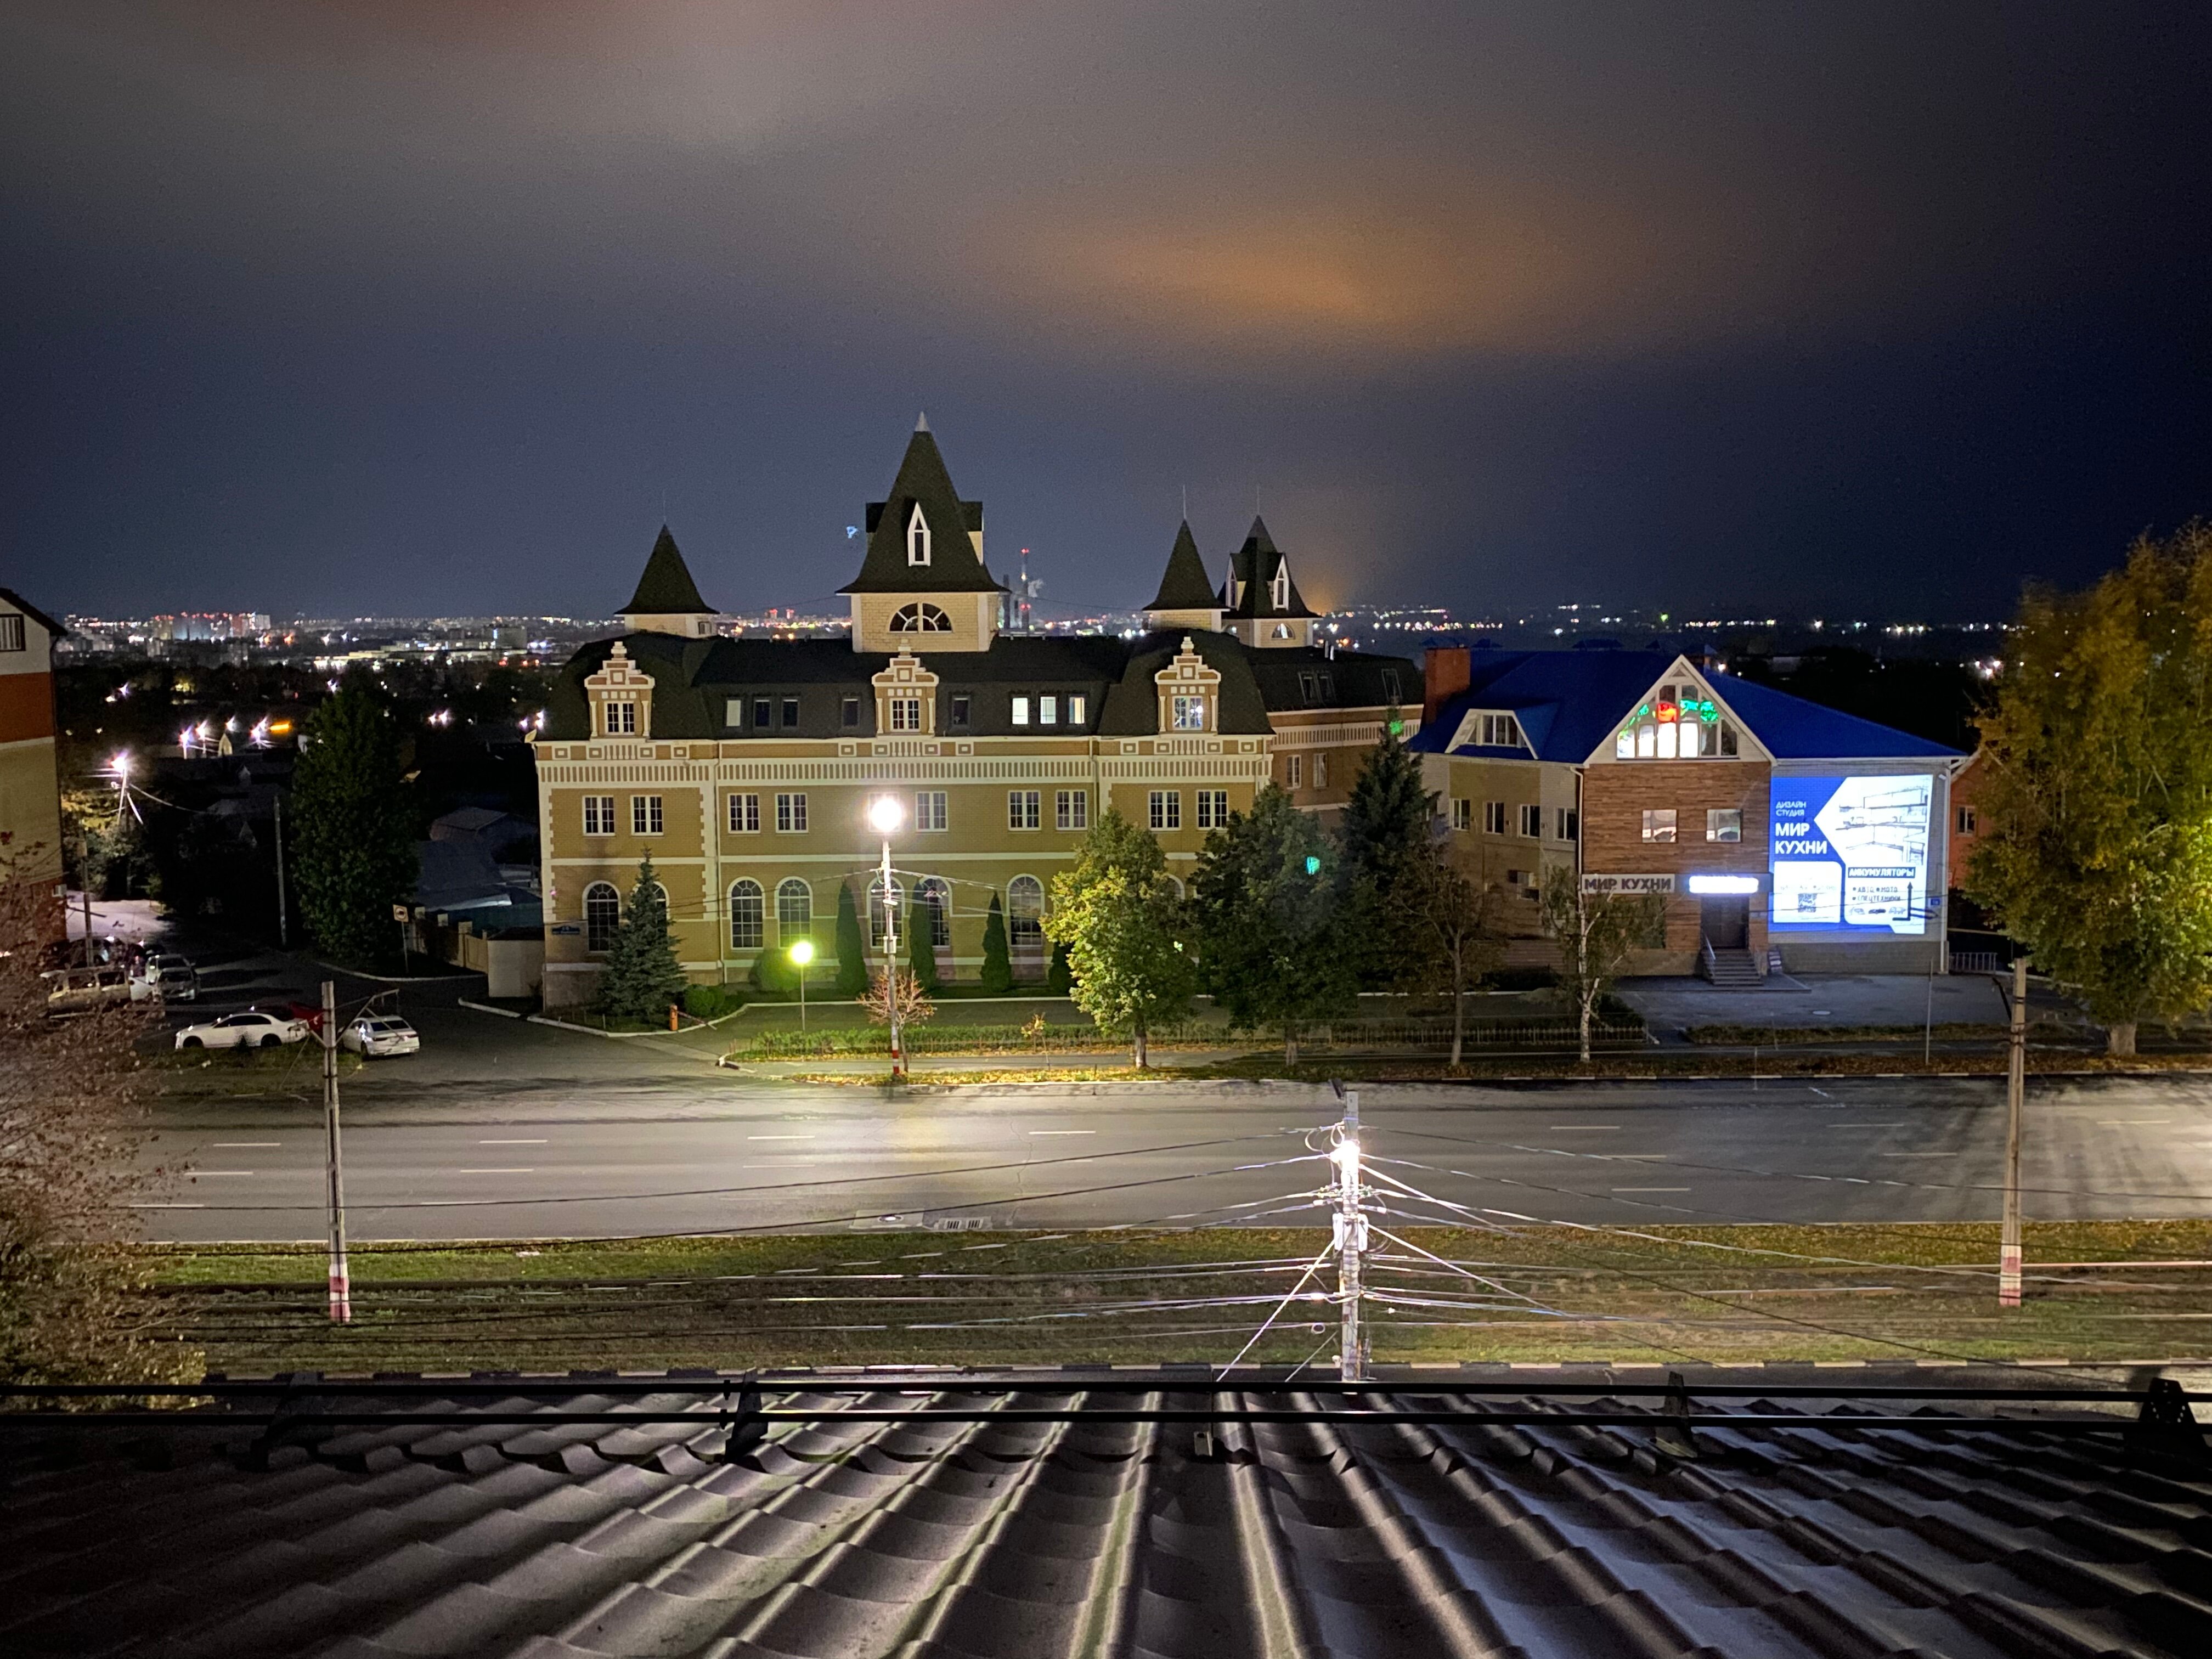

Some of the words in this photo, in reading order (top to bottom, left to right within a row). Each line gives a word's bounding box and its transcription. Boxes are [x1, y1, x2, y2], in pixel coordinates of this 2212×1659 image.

[1775, 822, 1810, 837] МИР
[1775, 840, 1827, 854] КУХНИ
[1849, 868, 1914, 877] АККУМУЛЯТОРЫ
[1584, 878, 1617, 889] МИР
[1621, 878, 1671, 890] КУХНИ
